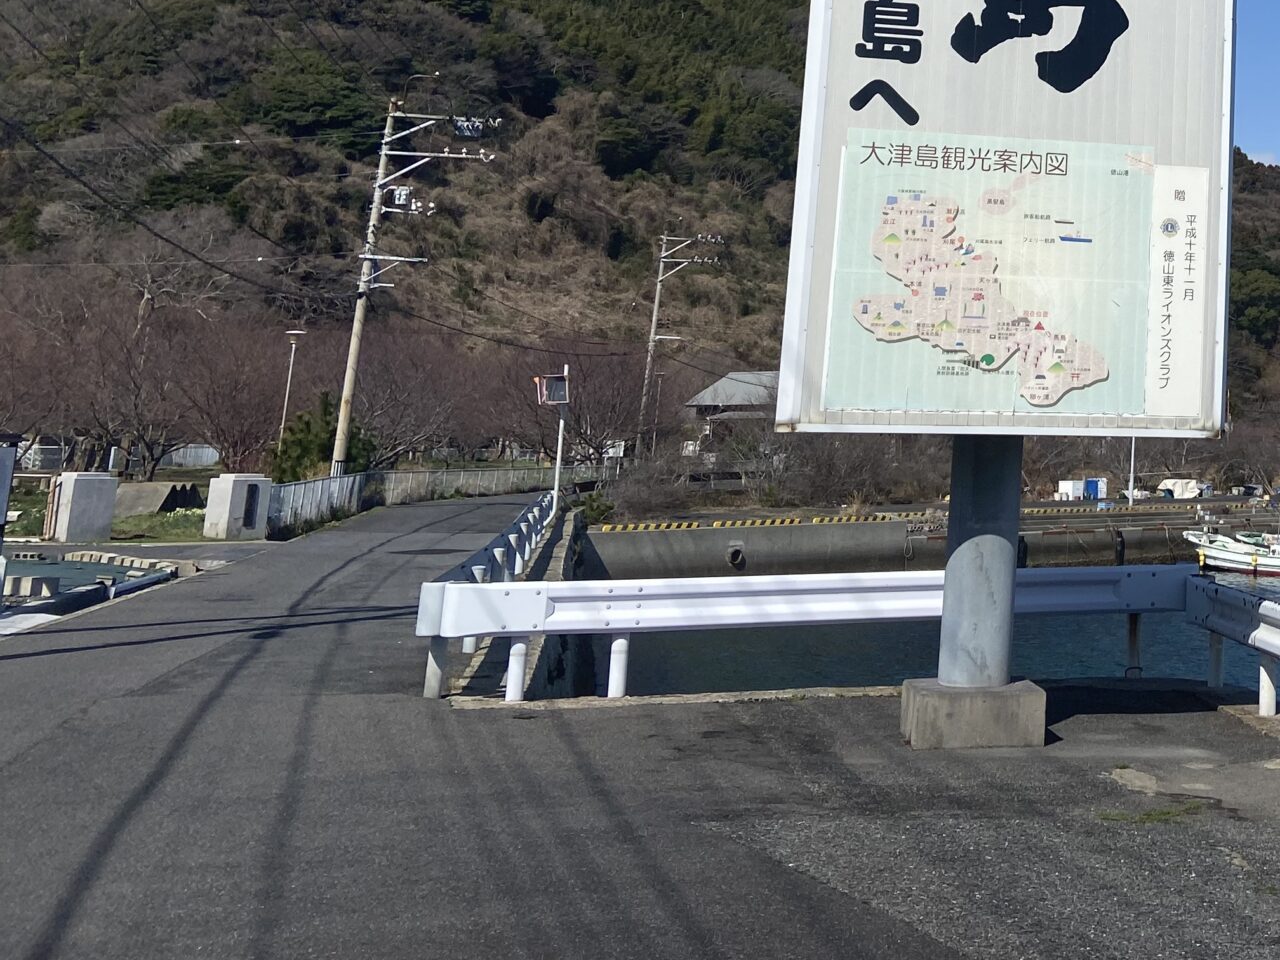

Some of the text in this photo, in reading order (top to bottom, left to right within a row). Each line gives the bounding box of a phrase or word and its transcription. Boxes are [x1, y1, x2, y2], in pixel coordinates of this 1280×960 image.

[860, 141, 1069, 176] 大津島観光案内図
[1174, 189, 1186, 202] 贈
[1183, 214, 1197, 301] 平成十年十一月
[1158, 250, 1175, 389] 徳山東ライオンズクラブ
